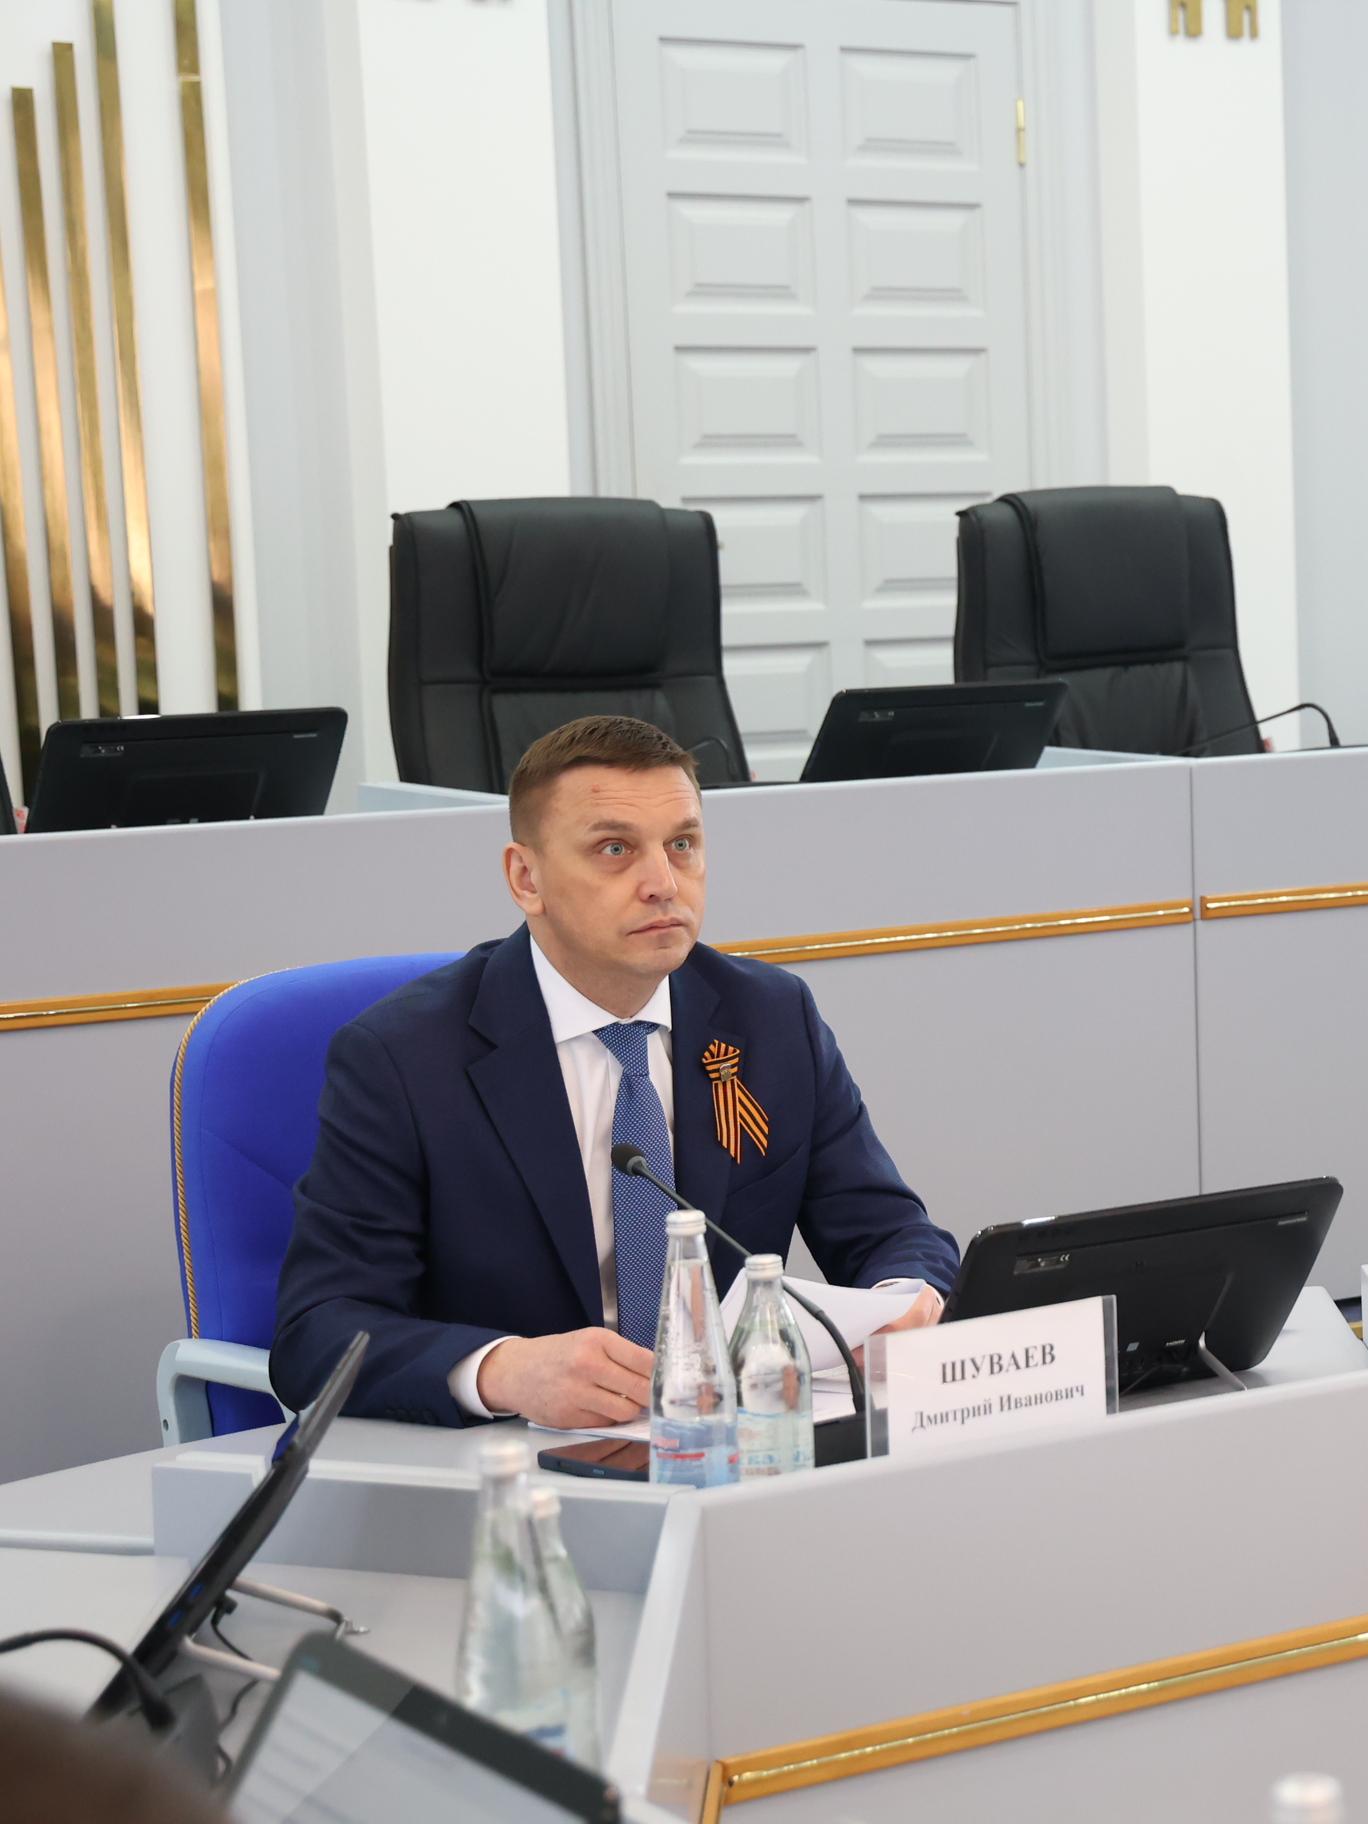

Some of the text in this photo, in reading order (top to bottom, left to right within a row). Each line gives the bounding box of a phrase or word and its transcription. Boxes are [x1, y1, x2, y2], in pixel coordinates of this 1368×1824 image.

[941, 1343, 1056, 1384] ШУВАЕВ
[911, 1384, 1085, 1432] Дмитрий Иванович
